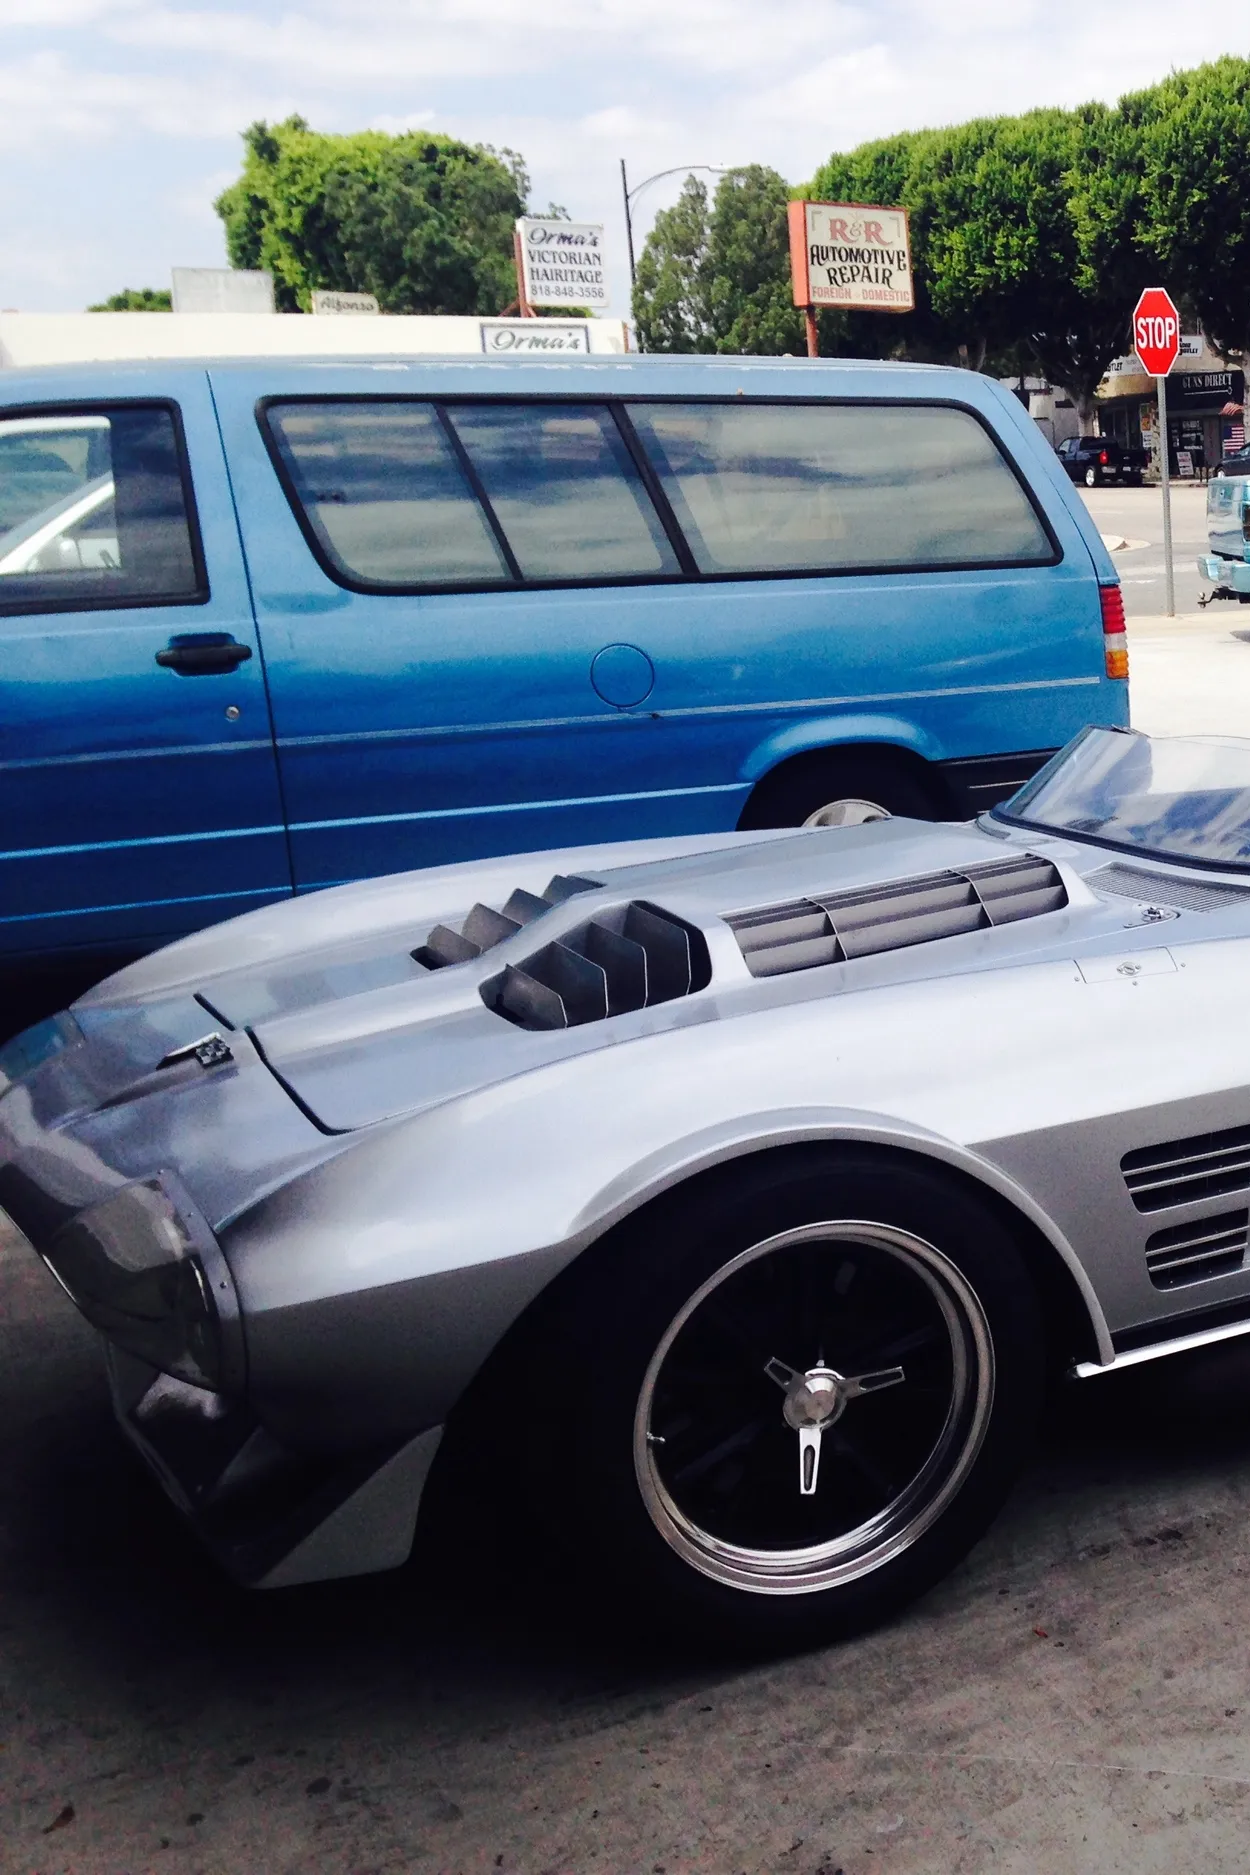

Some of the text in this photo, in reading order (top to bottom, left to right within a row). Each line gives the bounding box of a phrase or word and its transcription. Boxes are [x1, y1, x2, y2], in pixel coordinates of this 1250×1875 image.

[528, 227, 599, 247] Orma's
[528, 249, 602, 266] VICTORIAN
[809, 244, 907, 271] AUTOMOTIVE
[529, 267, 603, 284] HAIRITAGE
[826, 264, 894, 290] REPAIR
[531, 285, 605, 299] 818-848-3556
[811, 286, 911, 302] FOREIGN DOMESTIC
[491, 330, 580, 351] Orma's
[1137, 316, 1176, 349] STOP
[1204, 372, 1233, 387] DIRECT
